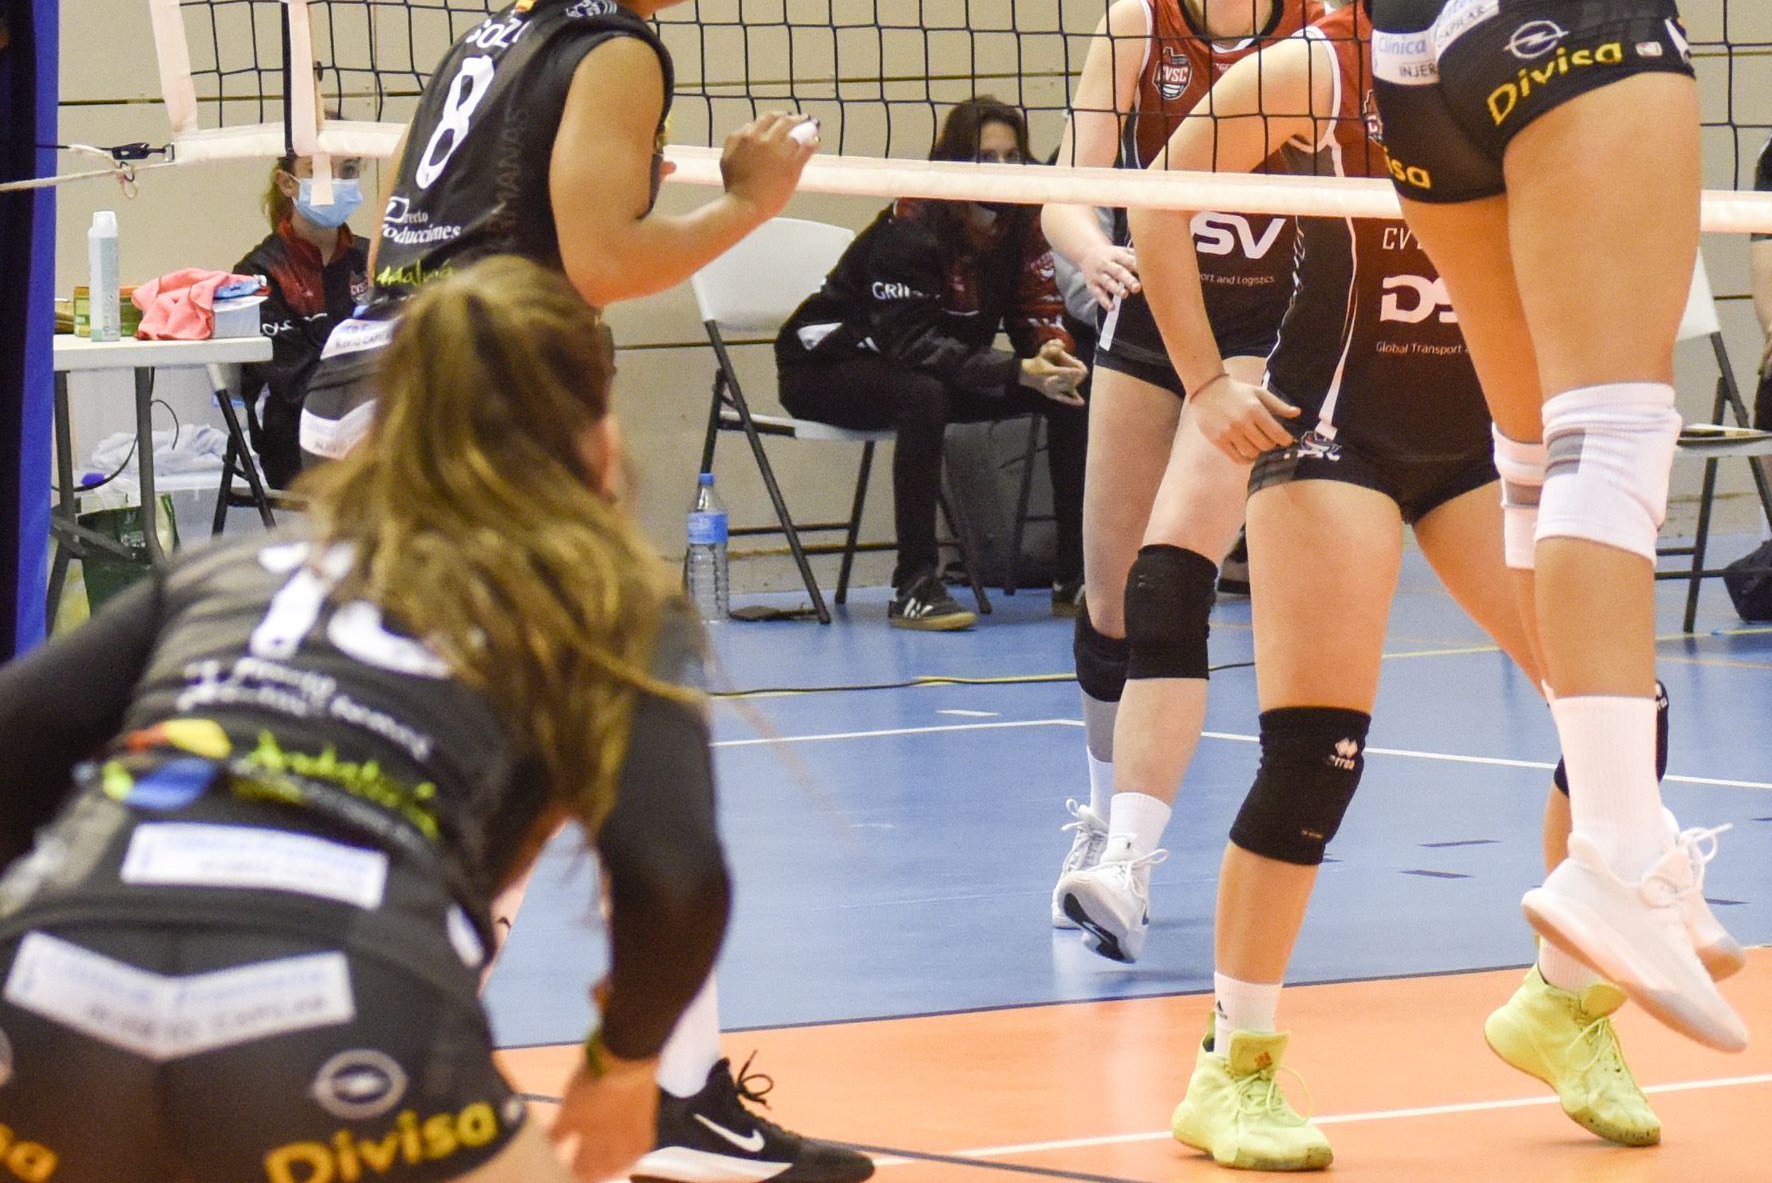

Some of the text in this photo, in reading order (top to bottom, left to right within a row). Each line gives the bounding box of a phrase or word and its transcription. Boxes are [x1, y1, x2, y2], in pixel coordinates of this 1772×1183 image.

[416, 54, 495, 190] 8
[1216, 275, 1235, 284] and
[1237, 275, 1275, 285] Logistics
[1375, 341, 1408, 355] Global
[1411, 342, 1461, 356] Transport
[263, 1102, 498, 1183] Divisa
